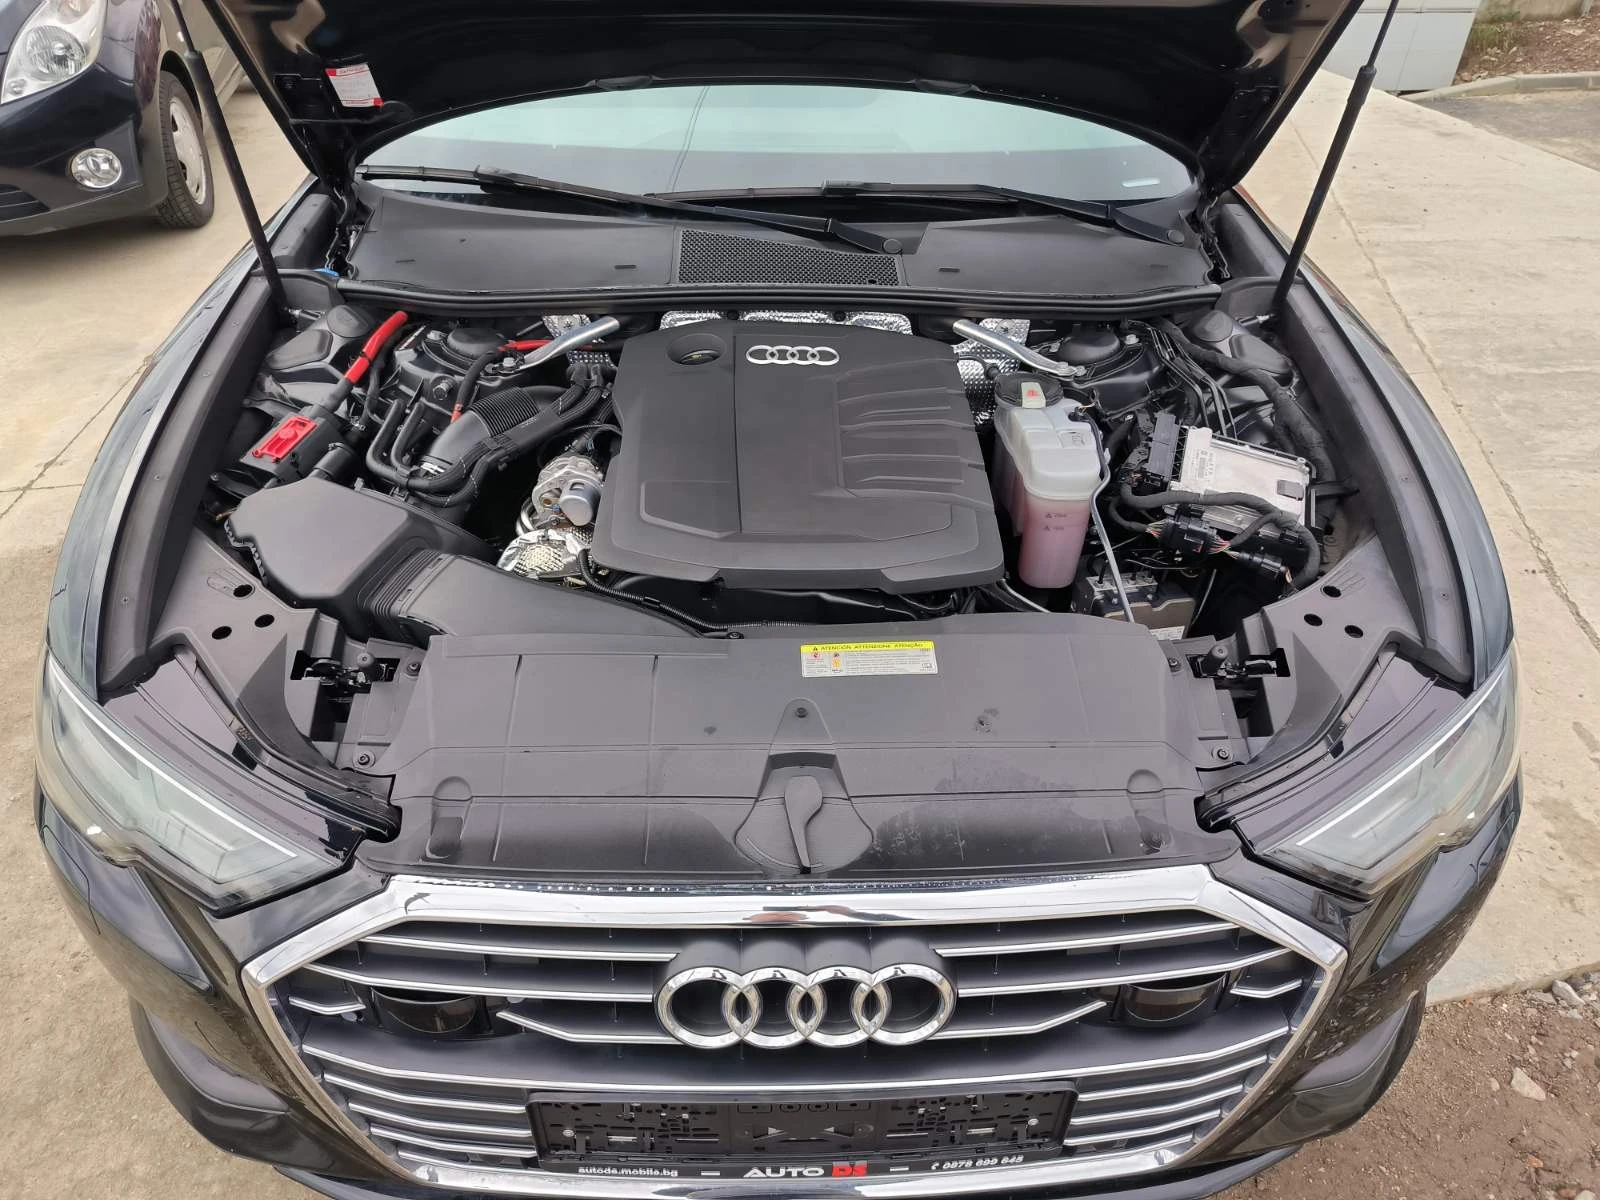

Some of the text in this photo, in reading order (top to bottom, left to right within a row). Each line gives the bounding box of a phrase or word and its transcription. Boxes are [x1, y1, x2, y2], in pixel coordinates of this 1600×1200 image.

[743, 1161, 868, 1178] AUTO DS
[942, 1159, 973, 1170] 0878
